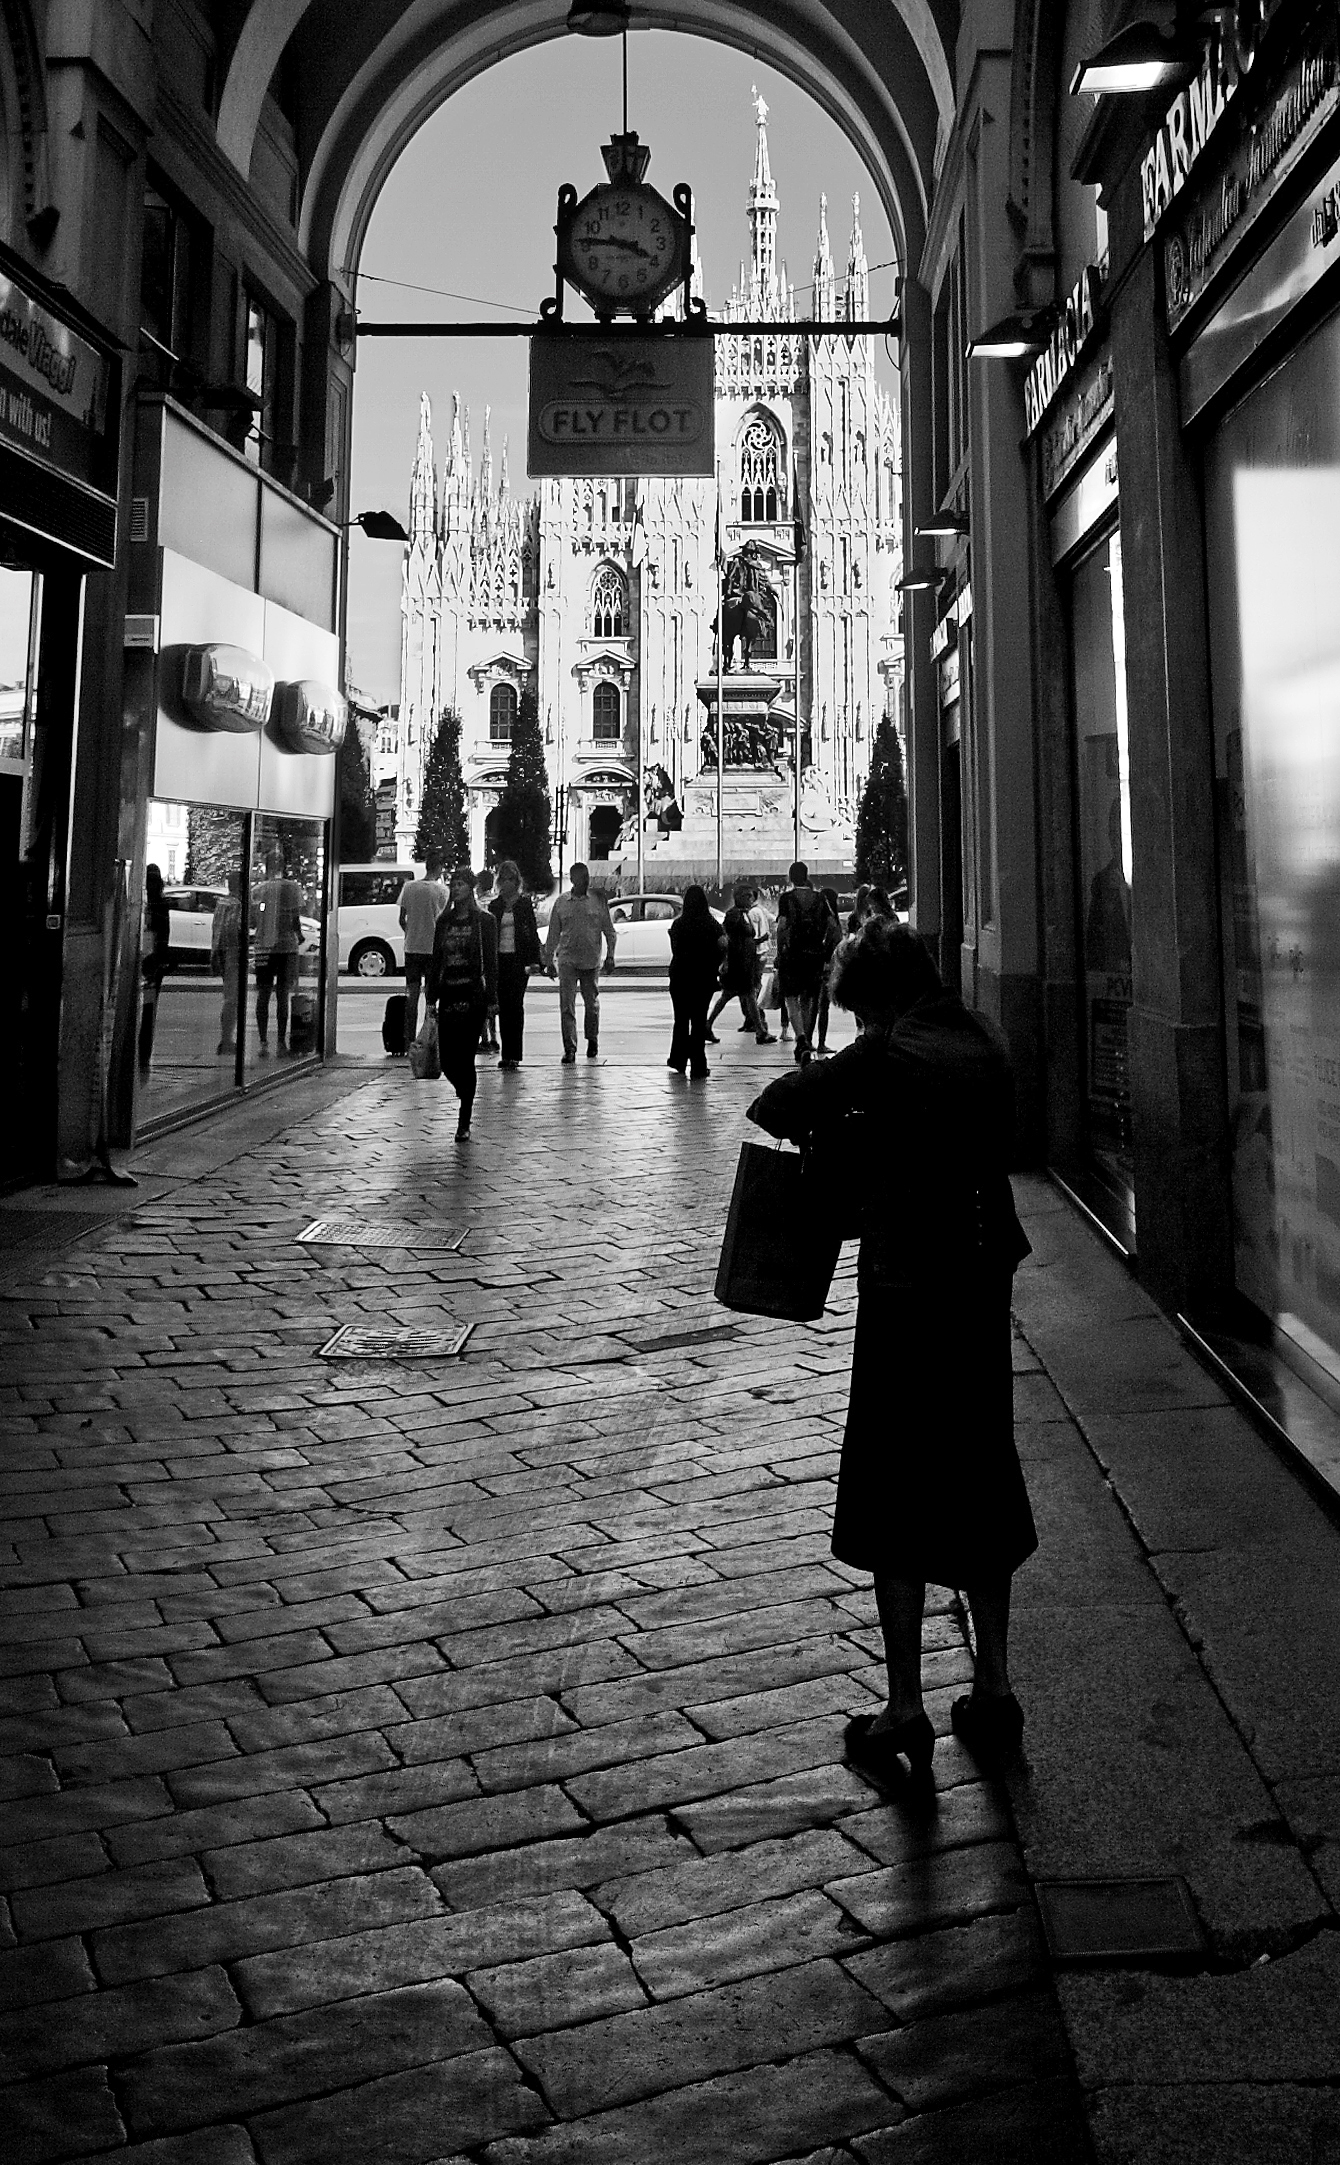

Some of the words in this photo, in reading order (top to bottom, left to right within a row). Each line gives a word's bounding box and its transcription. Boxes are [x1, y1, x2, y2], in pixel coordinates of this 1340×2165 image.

[597, 205, 610, 221] 11
[615, 201, 631, 216] 12
[638, 204, 644, 219] 1
[584, 220, 601, 234] 10
[650, 218, 660, 233] 2
[656, 236, 666, 251] 3
[602, 269, 611, 284] 7
[618, 274, 629, 290] 6
[552, 409, 604, 434] FLY
[613, 409, 692, 434] FLOT
